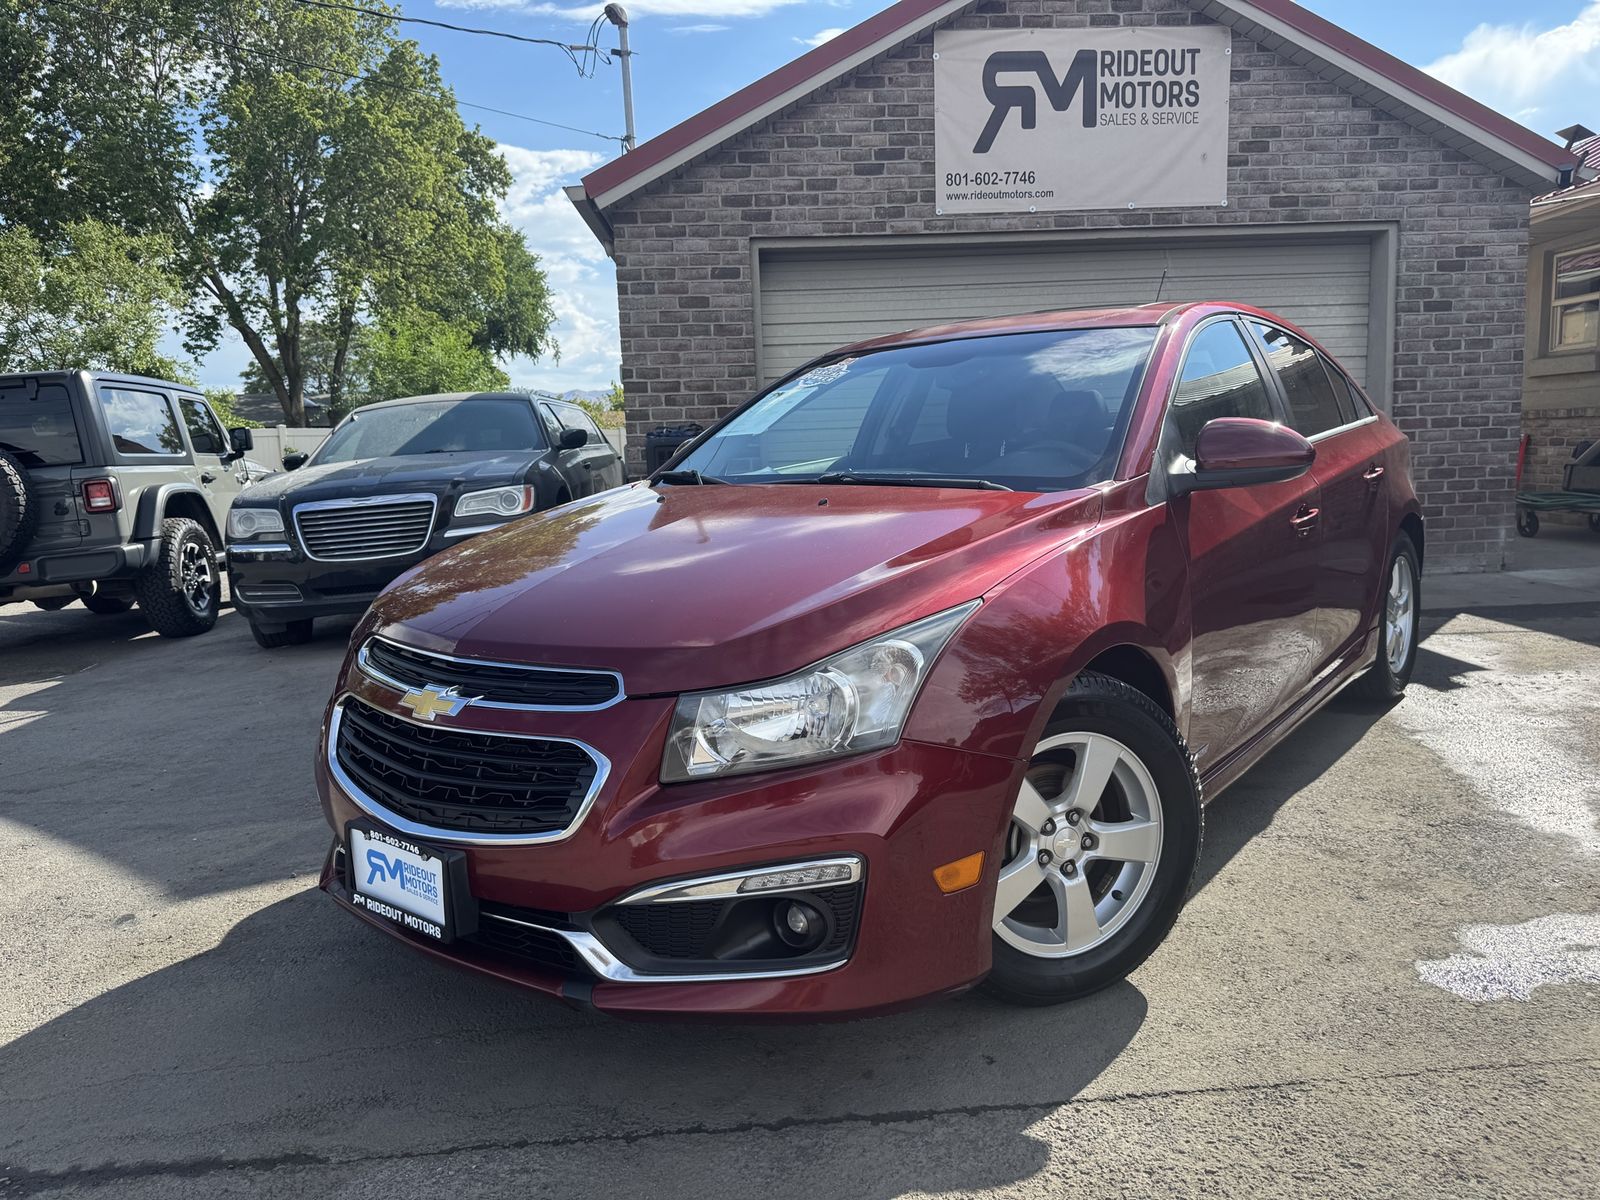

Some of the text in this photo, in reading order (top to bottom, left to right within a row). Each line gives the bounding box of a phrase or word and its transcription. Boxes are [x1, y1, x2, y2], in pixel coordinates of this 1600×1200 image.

[1100, 48, 1201, 77] RIDEOUT
[1100, 80, 1200, 109] MOTORS
[1100, 111, 1200, 126] SALES & SERVICE
[945, 171, 1036, 187] 801-602-7746
[945, 188, 1054, 201] www.rideoutmotors.com
[369, 830, 420, 855] 801-602-7746
[404, 862, 437, 884] RIDEOUT
[405, 876, 438, 898] MOTORS
[366, 898, 403, 923] RIDEOUT
[404, 913, 442, 939] MOTORS
